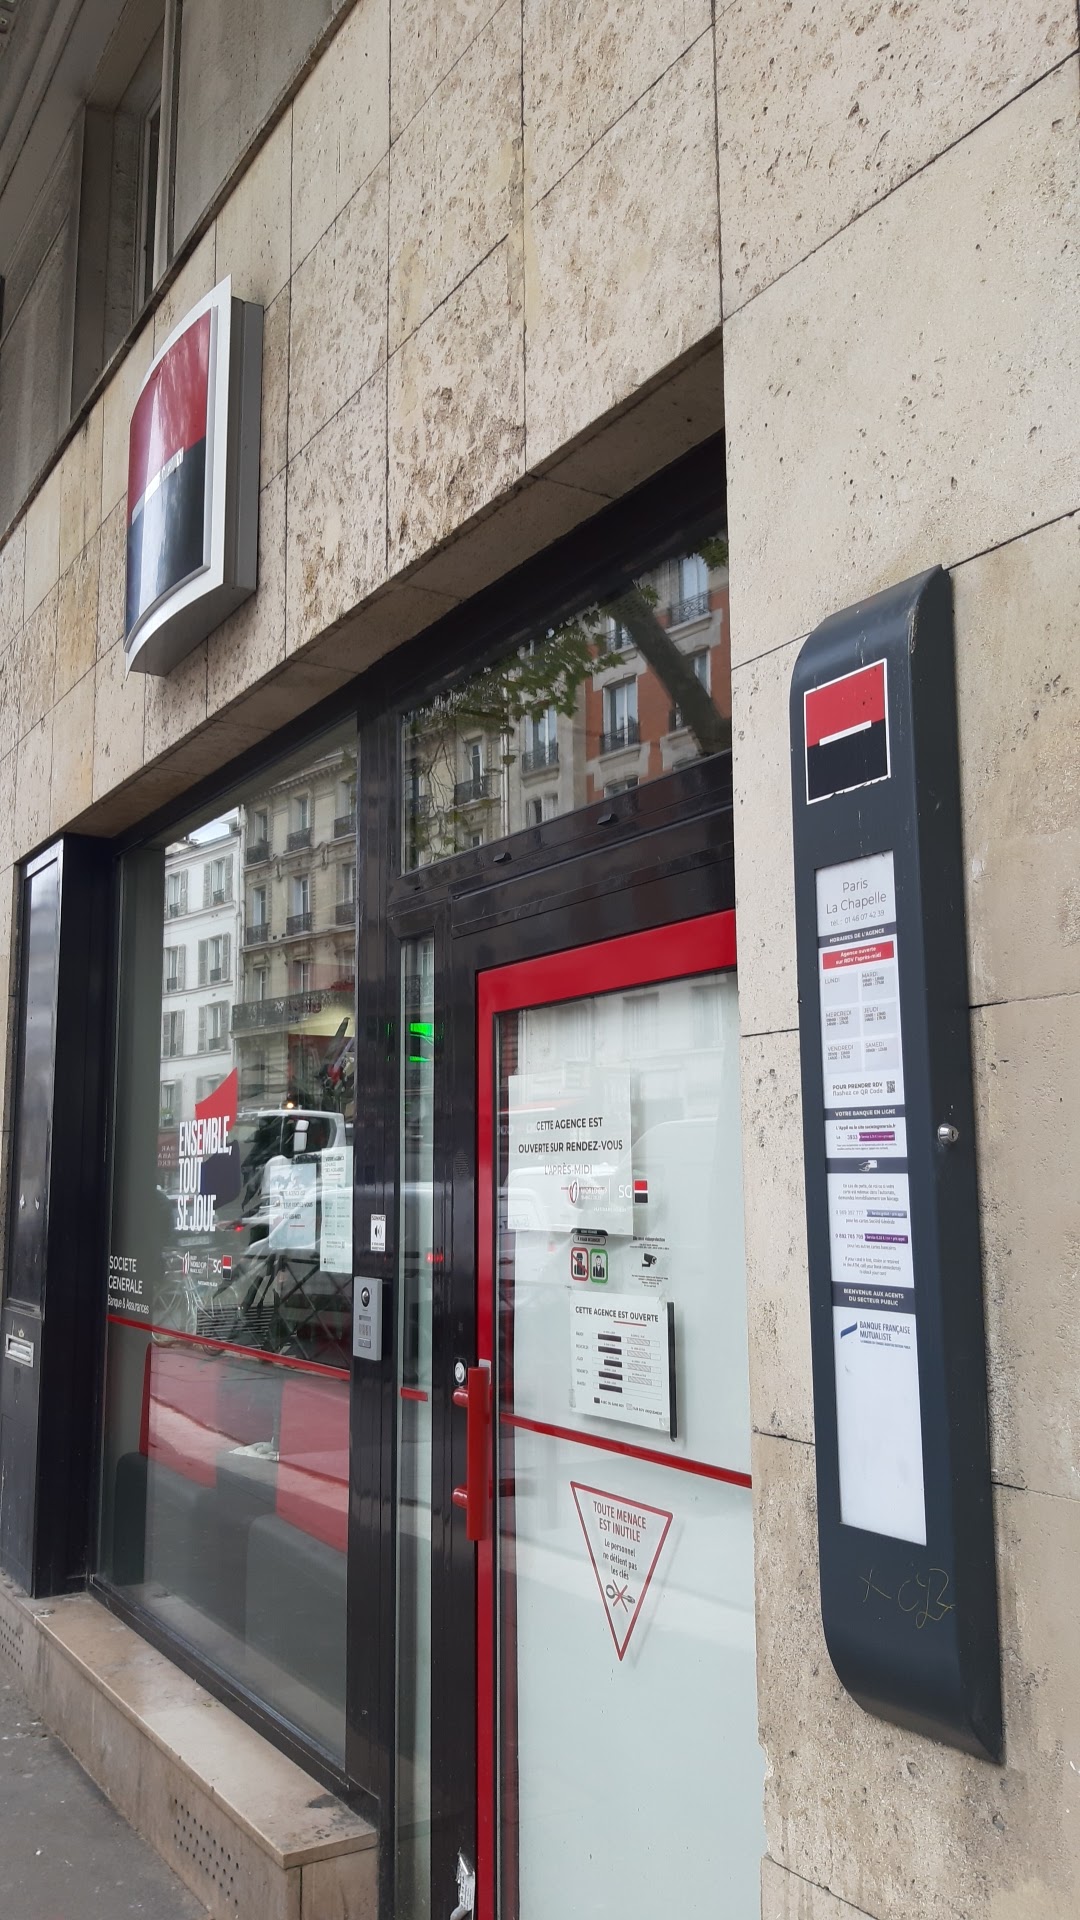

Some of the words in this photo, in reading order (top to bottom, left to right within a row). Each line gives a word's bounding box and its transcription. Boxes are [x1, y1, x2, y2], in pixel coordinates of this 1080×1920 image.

[843, 878, 868, 893] Paris
[827, 903, 838, 915] La
[841, 892, 887, 911] Chapelle
[861, 913, 868, 921] 07
[869, 911, 877, 919] 42
[830, 934, 853, 944] HORAIRES
[862, 928, 885, 938] L'AGENCE
[537, 1120, 554, 1131] CETTE
[555, 1118, 586, 1130] AGENCE
[588, 1117, 603, 1128] EST
[179, 1116, 232, 1157] ENSEMBLE,
[519, 1143, 549, 1153] OUVERTE
[550, 1142, 563, 1152] SUR
[566, 1140, 623, 1152] RENDEZ-VOUS
[179, 1157, 203, 1193] TOUT
[544, 1163, 593, 1175] L'APRÈS-MIDI
[619, 1185, 632, 1198] SG
[177, 1194, 189, 1231] SE
[190, 1194, 216, 1232] JOUE
[110, 1255, 137, 1272] SOCIETE
[213, 1260, 221, 1273] SG
[109, 1275, 143, 1294] GENERALE
[844, 1288, 872, 1296] BIENVENUE
[108, 1294, 122, 1309] Banque
[126, 1299, 150, 1314] Assurances
[857, 1296, 879, 1304] SECTEUR
[575, 1306, 592, 1315] CETTE
[594, 1308, 616, 1318] AGENCE
[618, 1310, 629, 1319] EST
[630, 1312, 659, 1323] OUVERTE
[860, 1321, 881, 1331] BANQUE
[883, 1323, 911, 1335] FRANÇAISE
[860, 1330, 892, 1341] MUTUALISTE
[593, 1501, 614, 1519] TOUTE
[617, 1508, 646, 1530] MENACE
[599, 1518, 611, 1532] EST
[613, 1523, 640, 1543] INUTILE
[605, 1538, 610, 1547] Le
[611, 1542, 636, 1557] personnel
[603, 1552, 609, 1560] ne
[610, 1553, 627, 1566] détient
[628, 1561, 637, 1571] pas
[619, 1569, 629, 1580] clés
